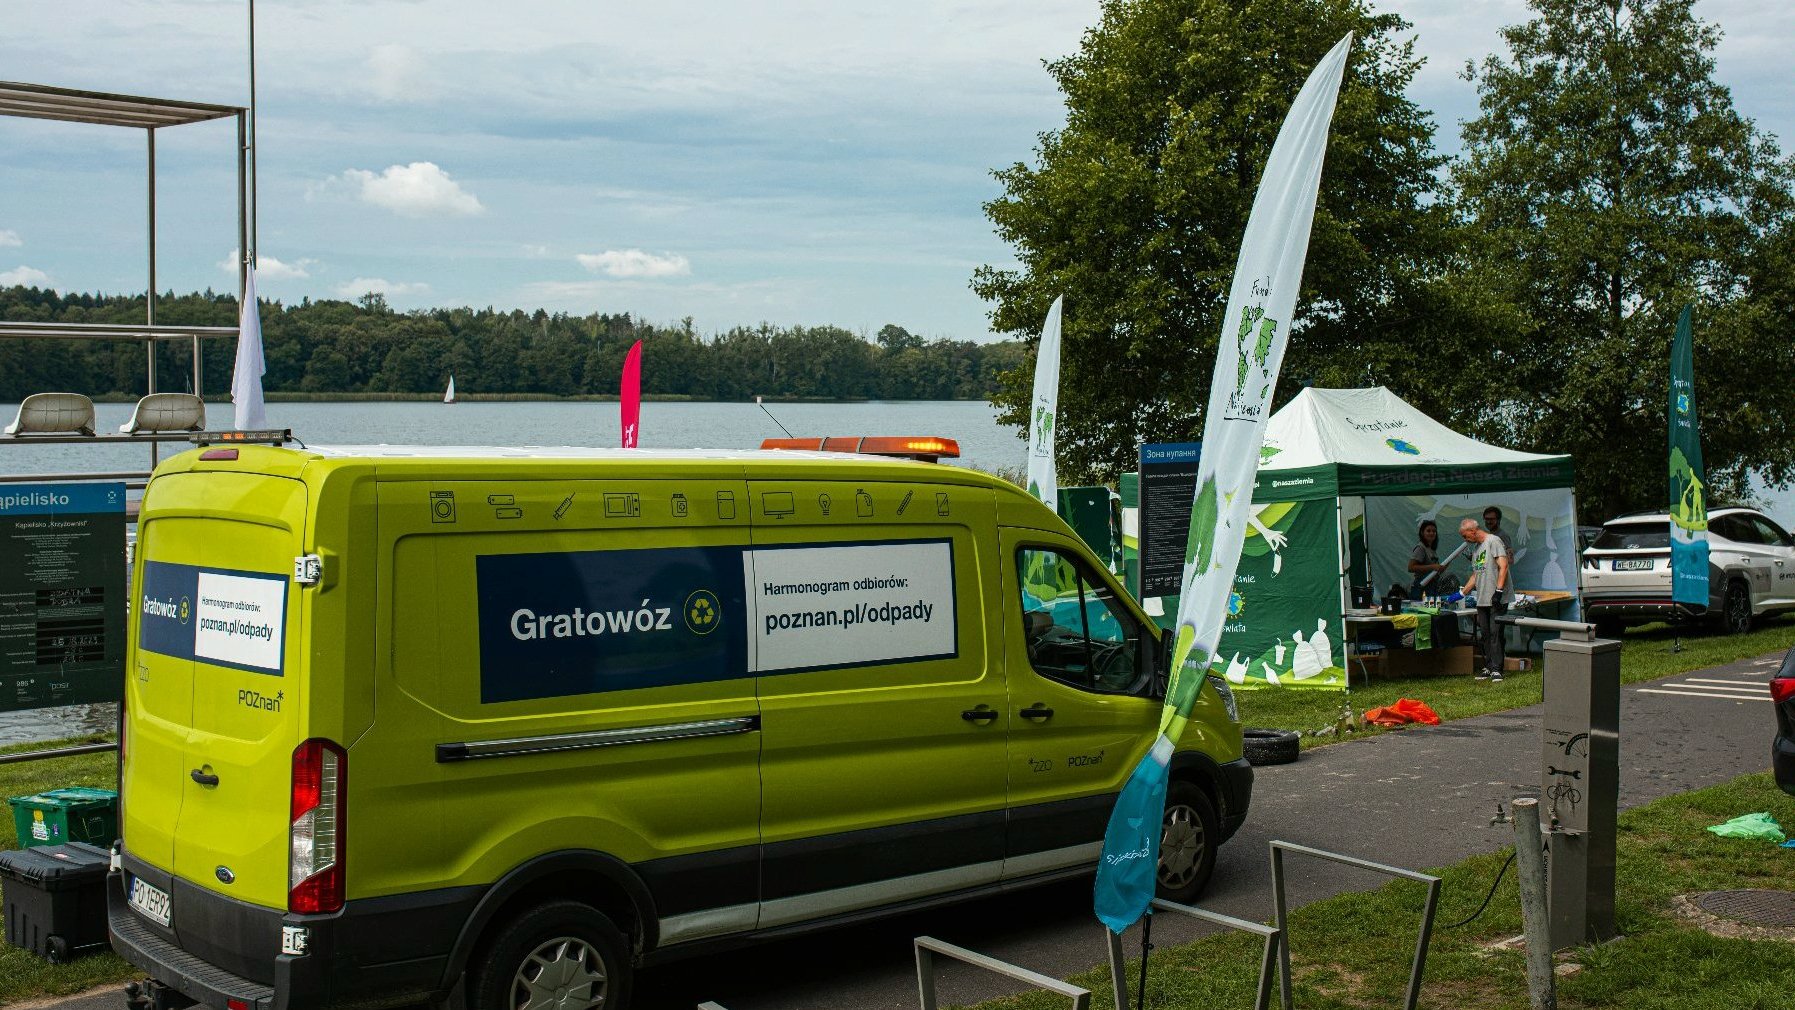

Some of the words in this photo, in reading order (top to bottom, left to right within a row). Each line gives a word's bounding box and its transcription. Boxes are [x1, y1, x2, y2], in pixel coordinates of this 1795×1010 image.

[1146, 449, 1165, 459] Зона
[1360, 469, 1446, 486] Fundacja
[1451, 466, 1503, 481] Nasza
[1505, 464, 1561, 478] Ziemia
[0, 491, 69, 510] ąpielisko
[763, 579, 850, 597] Harmonogram
[852, 574, 909, 592] odbiorów:
[143, 595, 177, 619] Gratowóz
[201, 596, 234, 612] Harmonogram
[234, 599, 261, 613] odbiorów:
[509, 597, 673, 641] Gratowóz
[764, 599, 934, 635] poznan.pl/odpady
[200, 617, 273, 642] poznan.pl/odpady
[134, 879, 145, 904] PO
